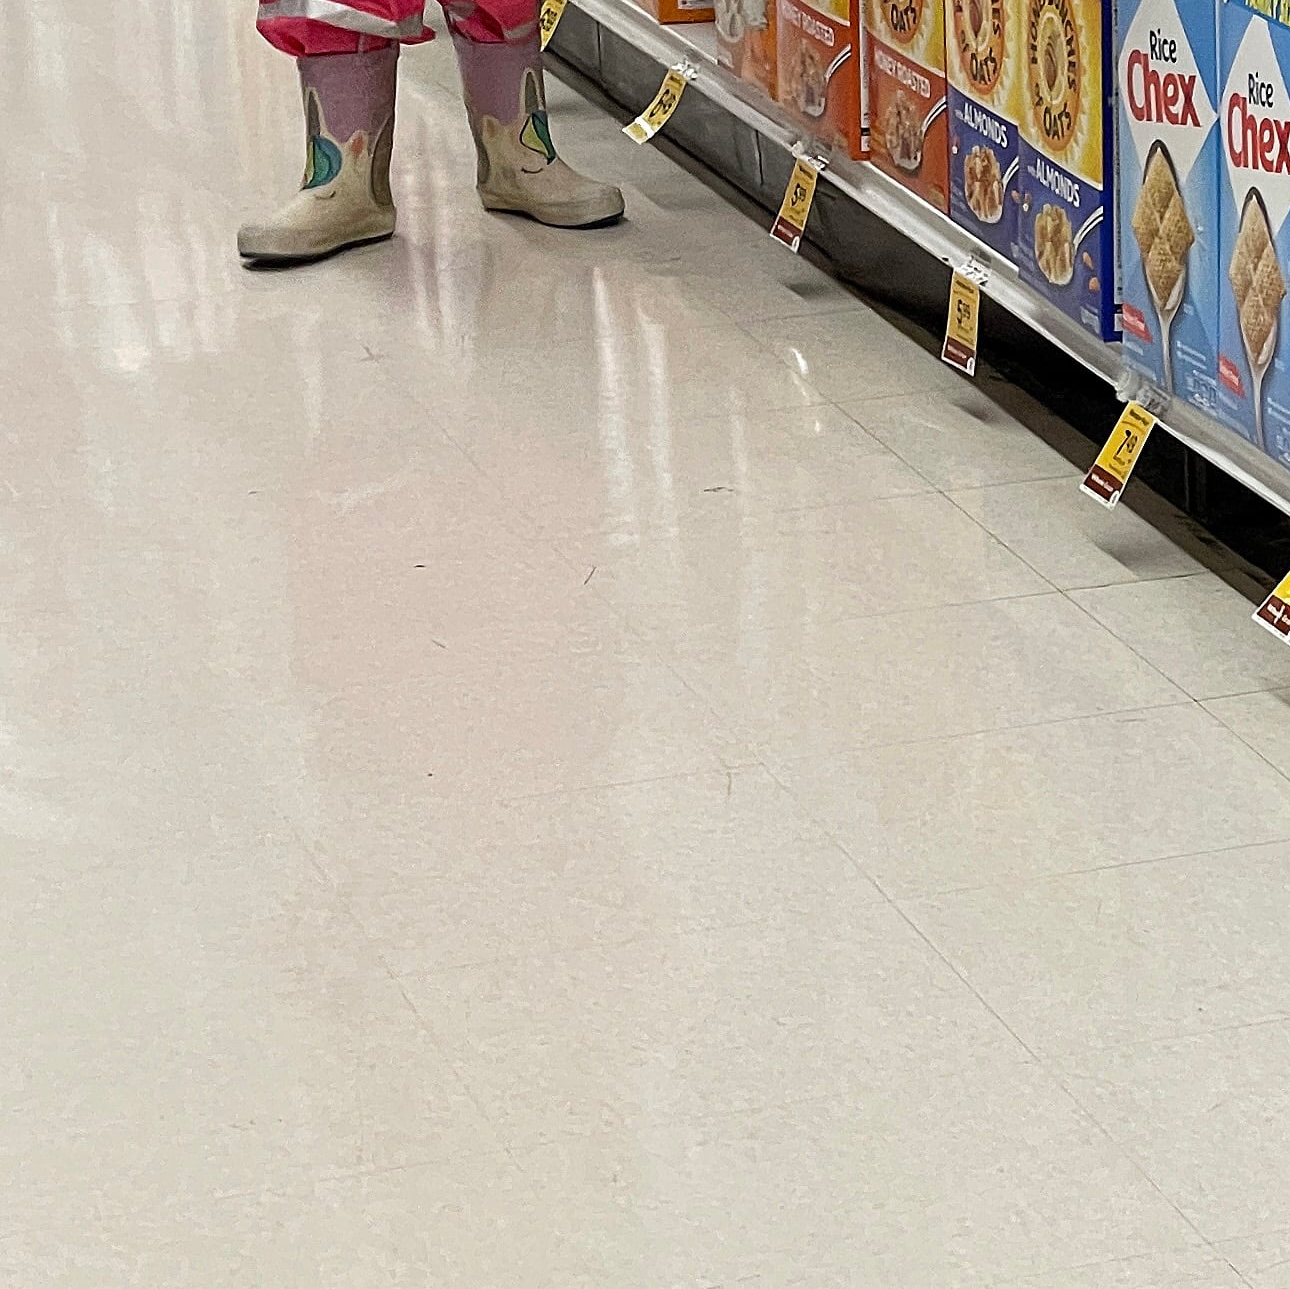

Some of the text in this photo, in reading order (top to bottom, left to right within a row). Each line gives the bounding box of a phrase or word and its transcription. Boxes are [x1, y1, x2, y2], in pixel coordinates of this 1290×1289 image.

[1149, 28, 1177, 65] Rice
[1126, 49, 1202, 129] Chex
[1248, 71, 1274, 108] Rice
[964, 102, 1008, 148] ALMONDS
[1036, 158, 1080, 207] ALMONDS
